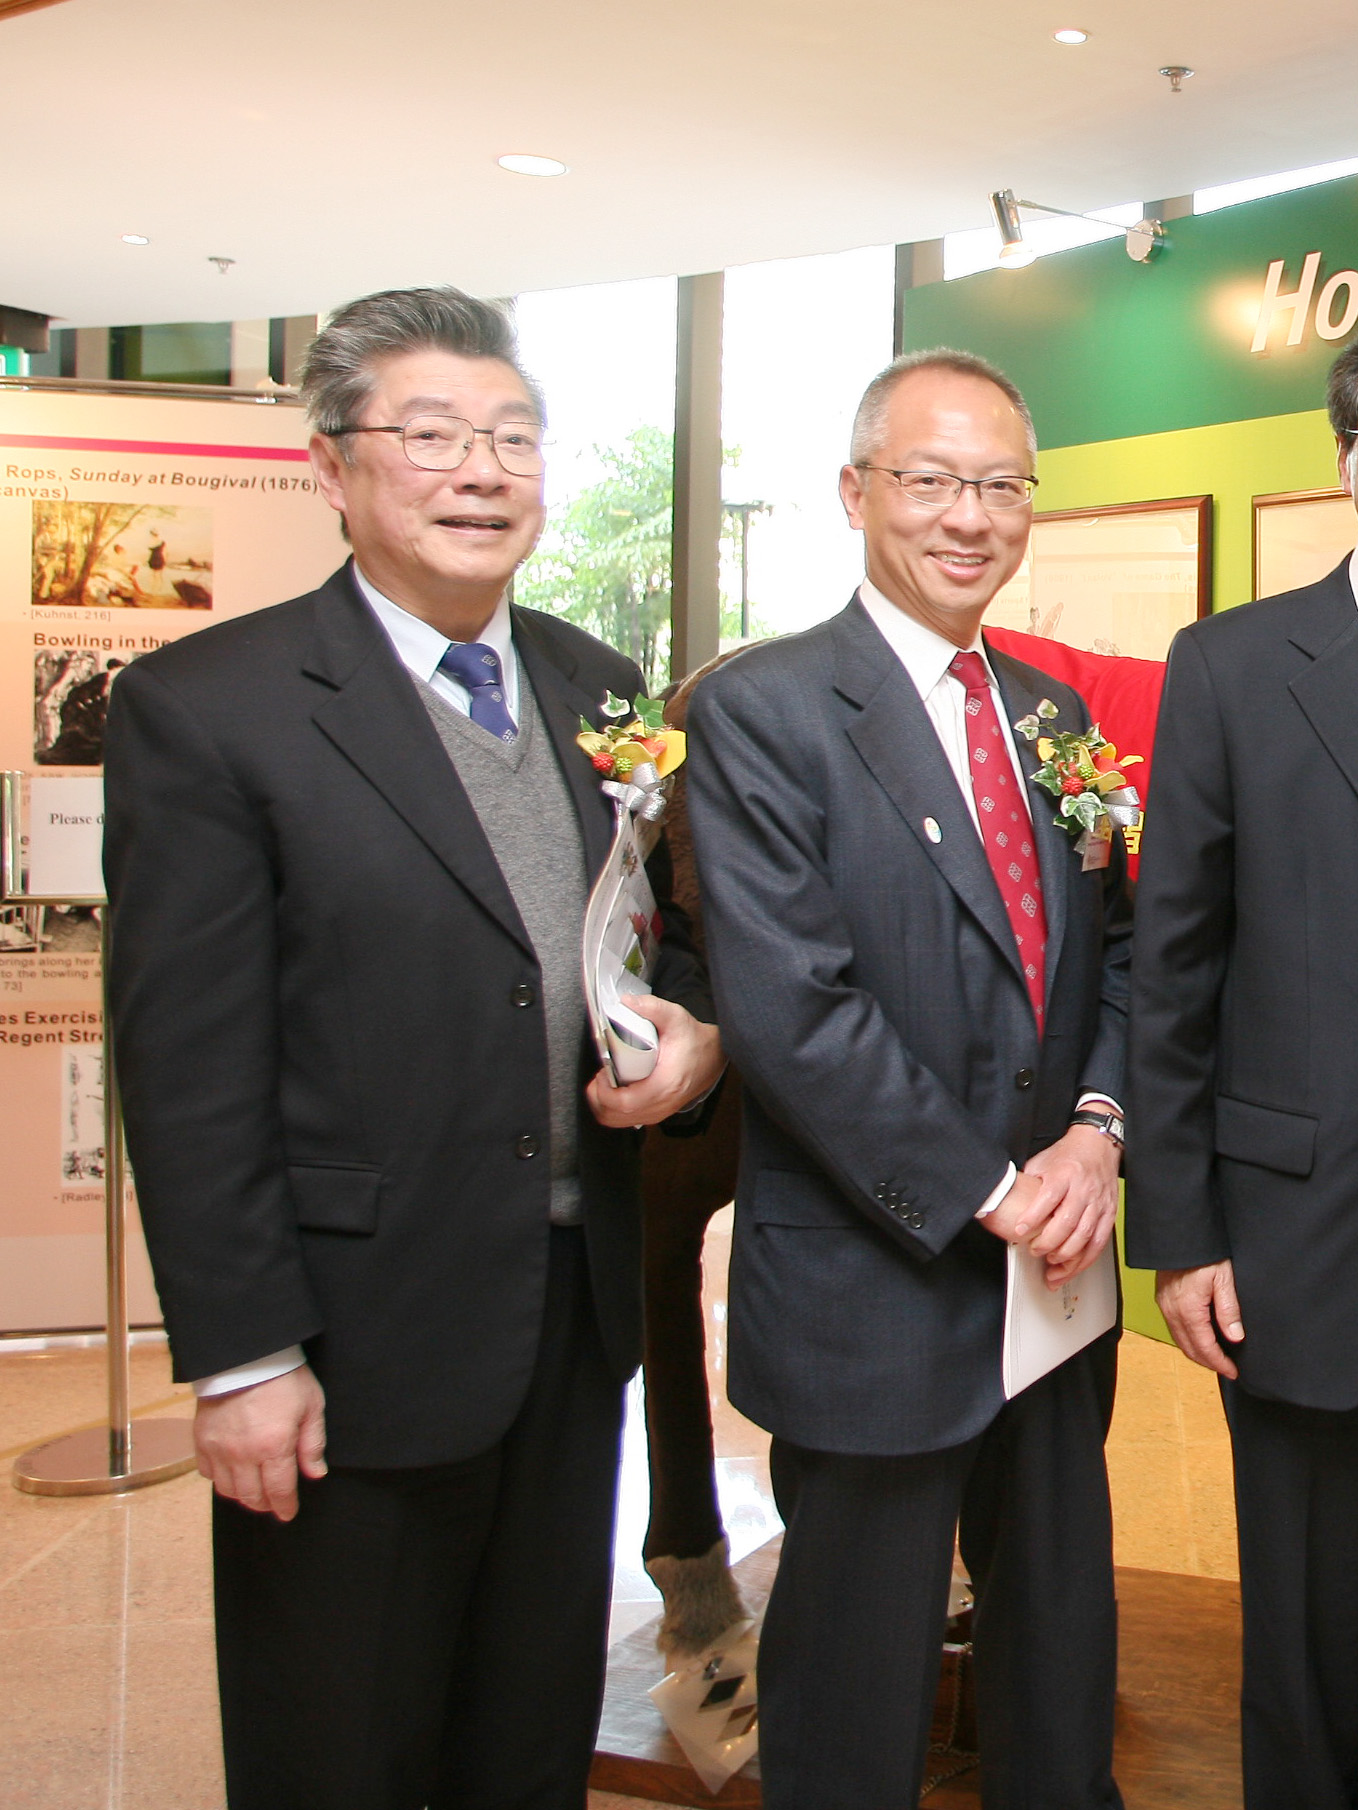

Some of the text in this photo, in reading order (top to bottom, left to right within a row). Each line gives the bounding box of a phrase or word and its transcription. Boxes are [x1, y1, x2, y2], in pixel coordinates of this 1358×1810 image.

[6, 464, 318, 494] Rops, Sunday at Bougival (1876)
[0, 485, 69, 502] anvas)
[34, 633, 112, 650] Bowling
[119, 635, 135, 648] in
[50, 813, 93, 825] Please
[39, 958, 72, 968] along
[76, 958, 94, 966] her
[18, 970, 37, 978] the
[42, 970, 89, 979] bowling
